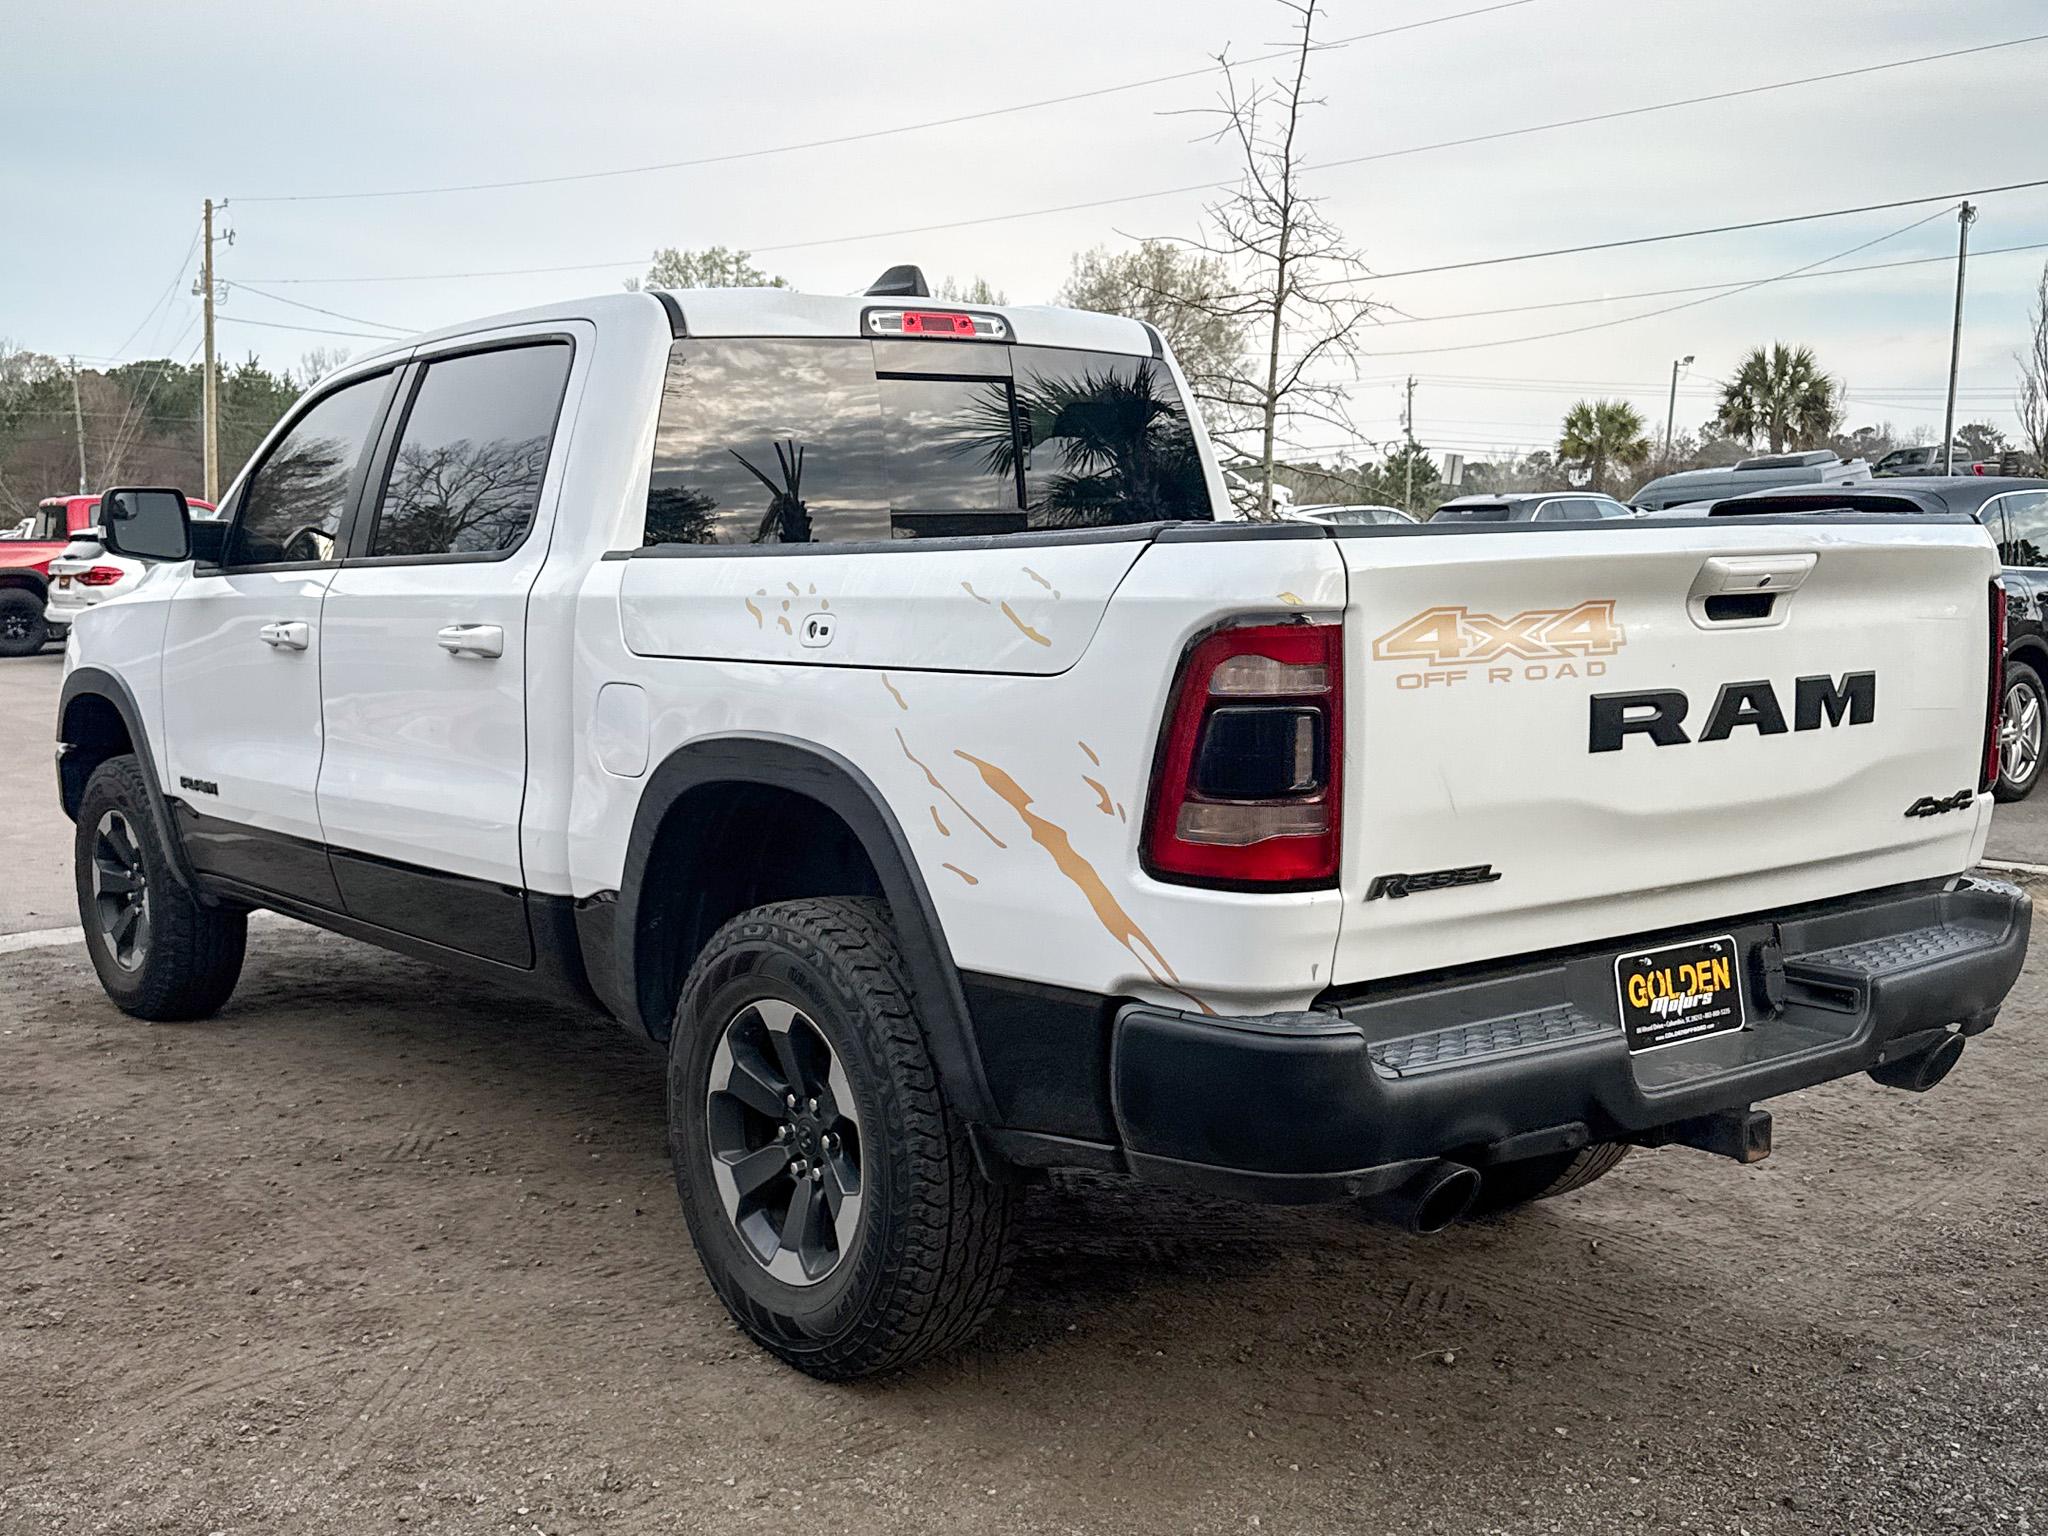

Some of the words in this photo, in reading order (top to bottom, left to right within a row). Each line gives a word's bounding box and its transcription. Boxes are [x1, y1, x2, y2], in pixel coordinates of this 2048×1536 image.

[1396, 670, 1468, 690] OFF
[1488, 660, 1607, 684] ROAD
[1588, 669, 1876, 754] RAM
[1628, 956, 1731, 1008] GOLDEN
[1650, 991, 1714, 1019] Motors
